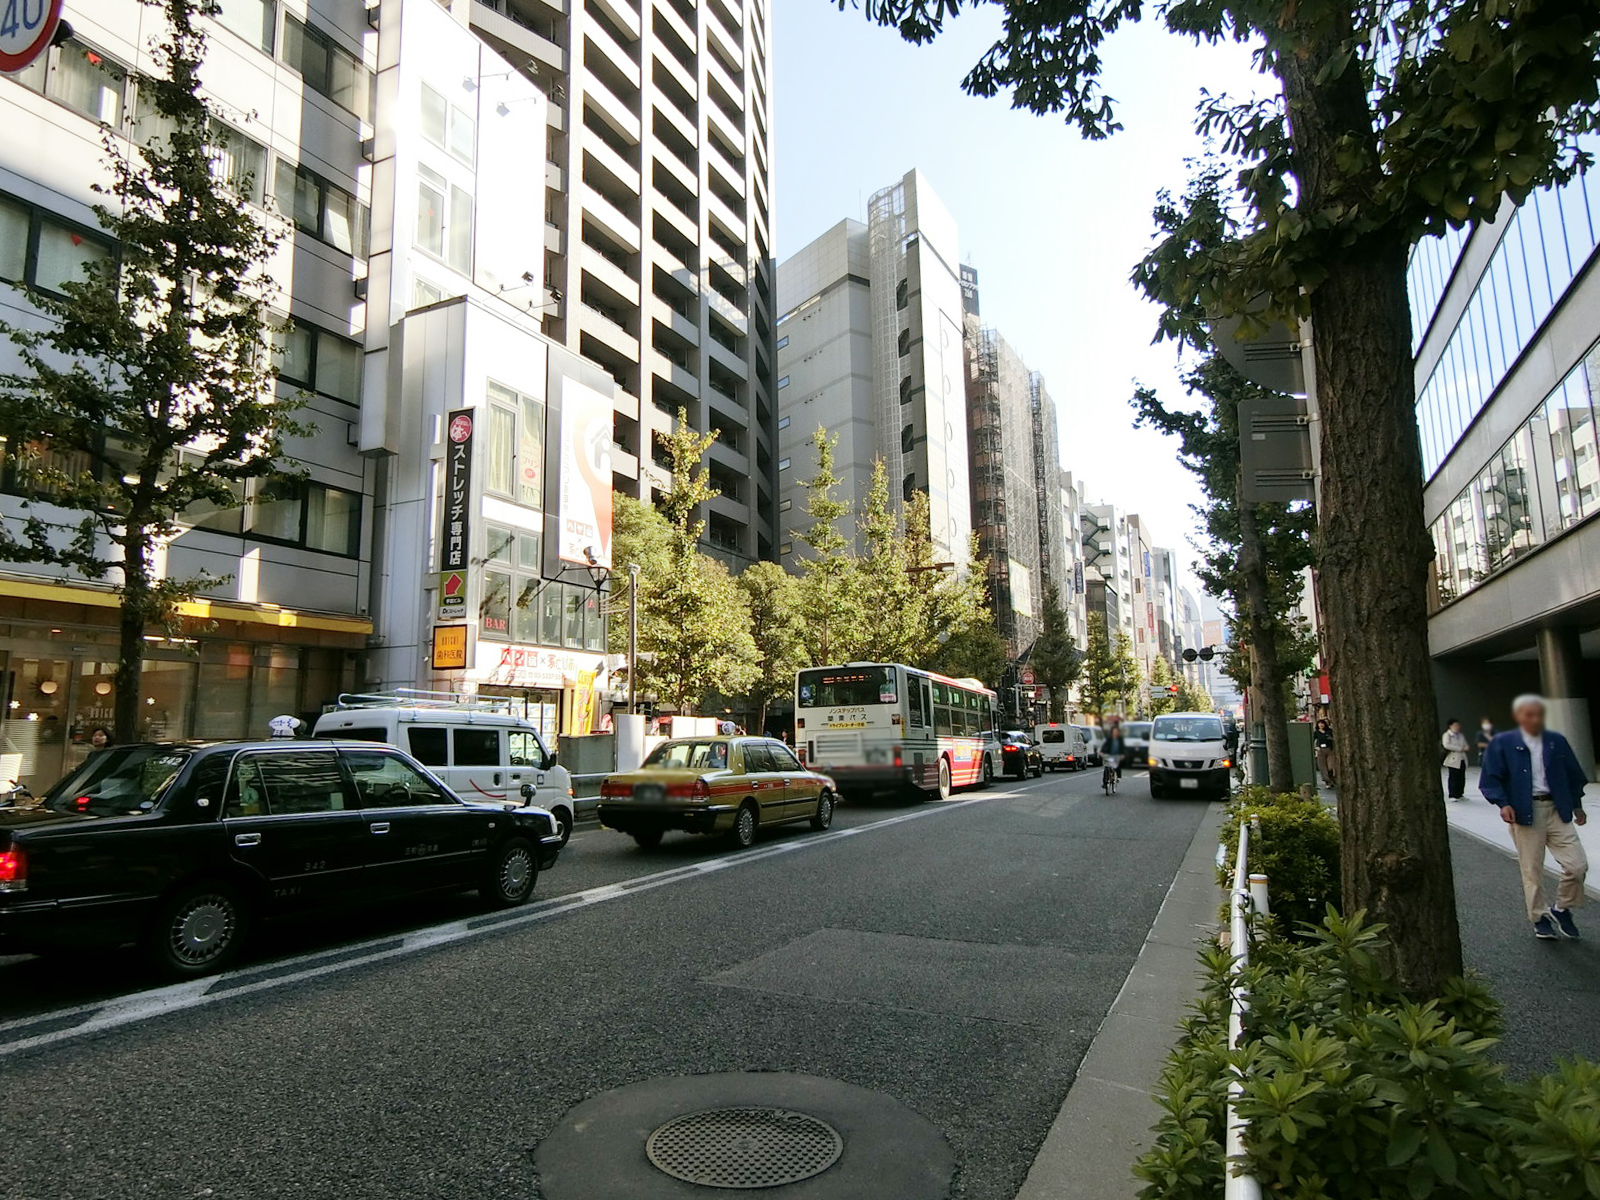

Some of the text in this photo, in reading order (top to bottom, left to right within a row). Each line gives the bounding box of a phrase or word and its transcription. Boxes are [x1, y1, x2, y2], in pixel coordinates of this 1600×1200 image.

[1, 0, 43, 38] 40
[449, 445, 466, 565] ストレッチ専門店
[485, 617, 506, 630] BAR
[159, 756, 181, 765] 342
